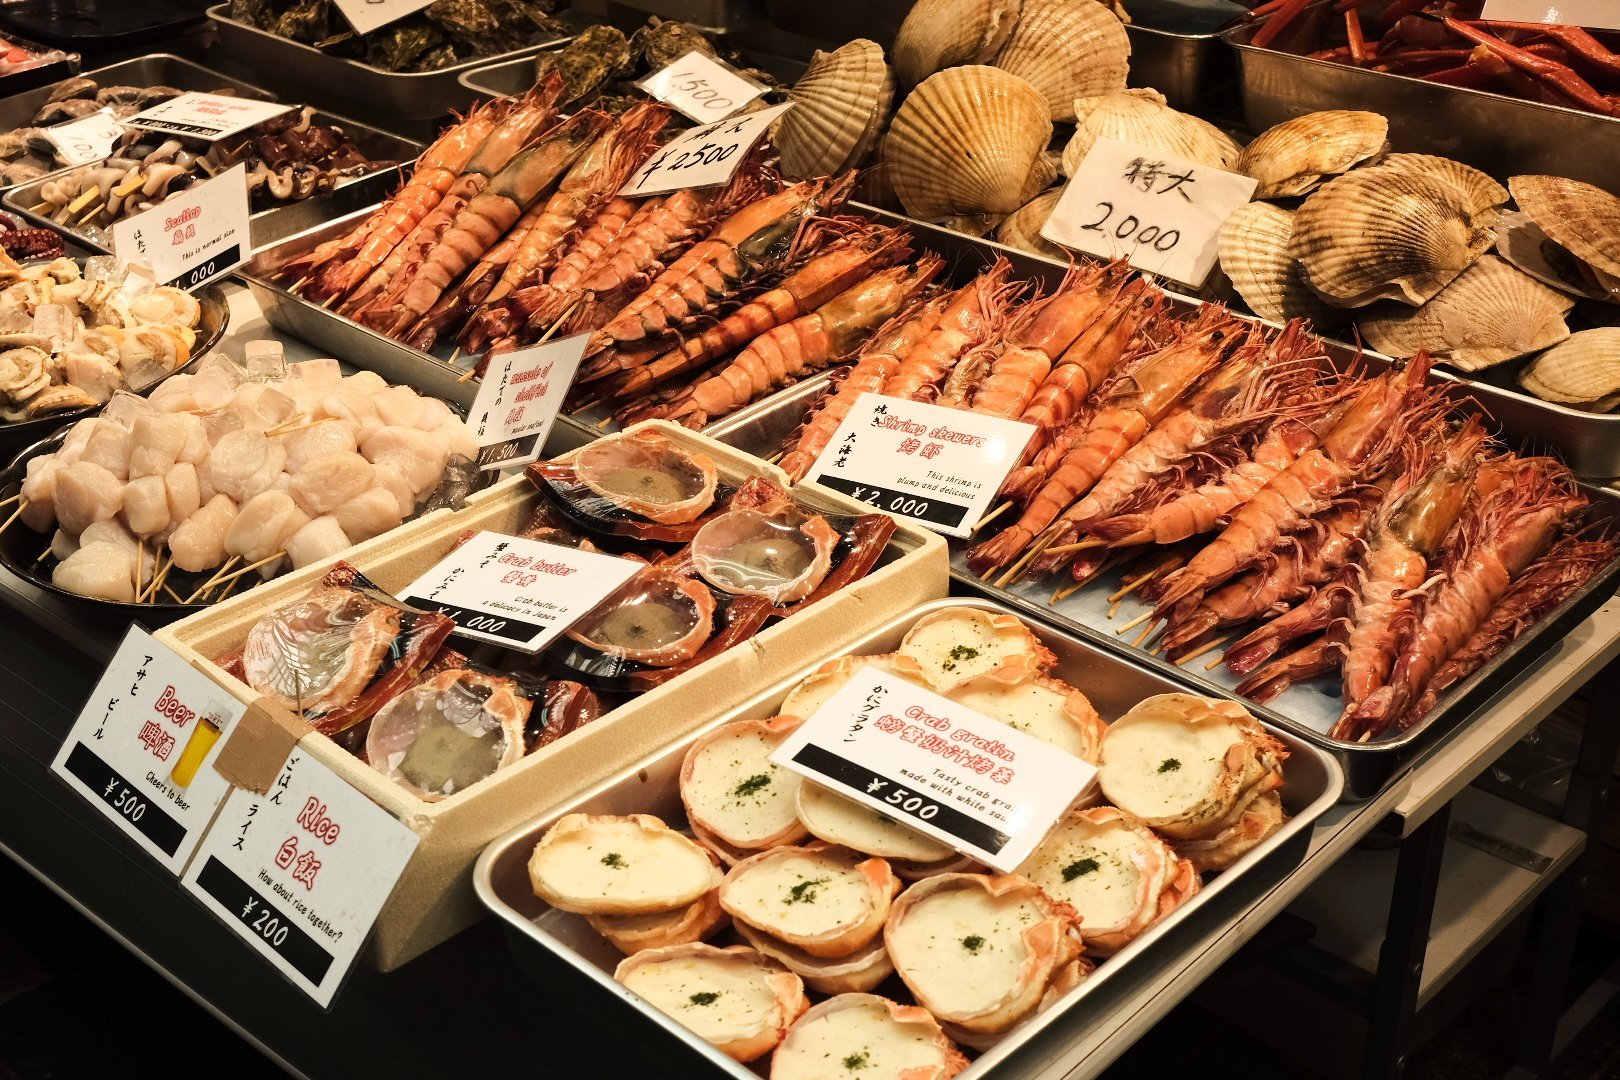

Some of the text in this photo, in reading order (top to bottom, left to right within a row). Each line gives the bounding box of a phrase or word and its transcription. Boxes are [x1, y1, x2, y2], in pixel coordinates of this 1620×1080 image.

[1124, 157, 1195, 203] 特大
[164, 206, 202, 232] Scallop
[182, 252, 194, 261] This
[202, 234, 222, 249] normal
[832, 431, 857, 468] 大海老
[878, 415, 987, 448] Shrimp skewers
[896, 476, 976, 500] plump and delicious
[926, 470, 983, 489] This shrimp is
[498, 552, 577, 576] Crab butter
[489, 601, 521, 613] delicacy
[532, 610, 557, 621] Japan
[533, 600, 558, 610] butter
[130, 655, 153, 696] アサヒ
[93, 697, 120, 740] ビール
[155, 685, 196, 728] Beer
[843, 684, 888, 743] かにグラタン
[138, 720, 176, 762] 啤酒
[904, 705, 1016, 762] Crab gratin
[145, 771, 191, 811] Cheers to beer
[270, 757, 300, 805] ごはん
[899, 768, 927, 784] made
[929, 782, 953, 797] with
[956, 795, 986, 811] white
[932, 768, 962, 786] Tasty
[965, 784, 990, 800] crab
[232, 803, 259, 851] ライス
[296, 796, 340, 846] Rice
[258, 868, 343, 943] How about rice together?
